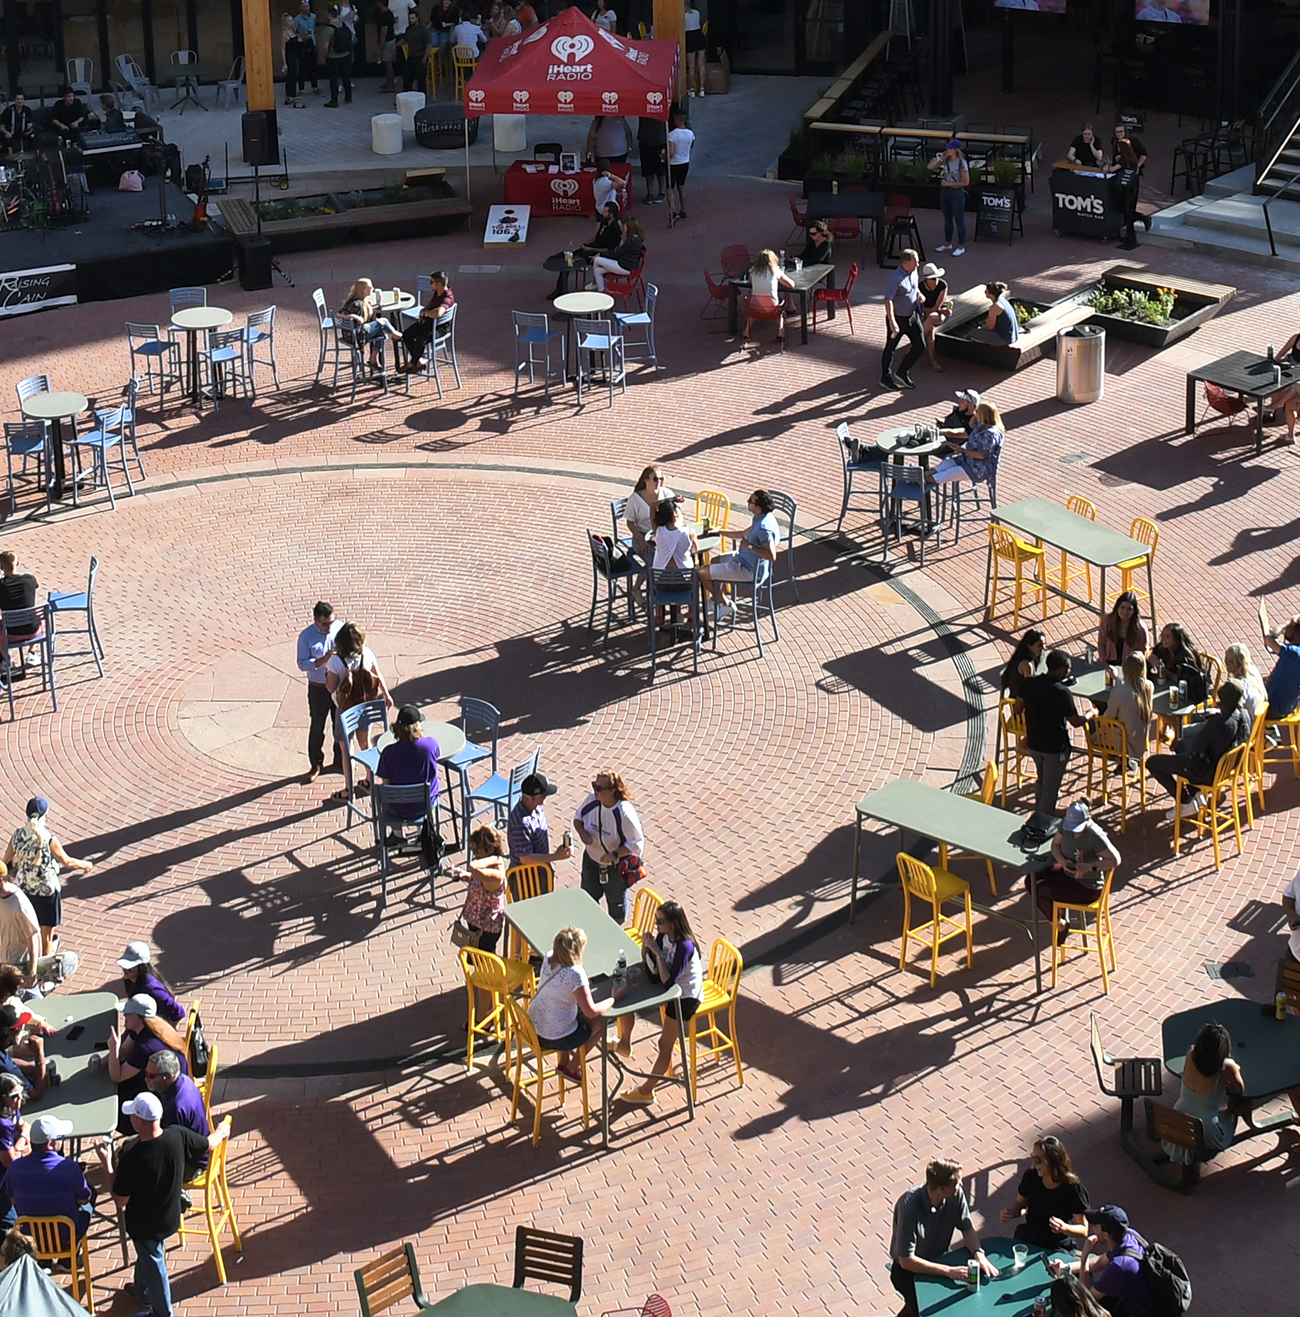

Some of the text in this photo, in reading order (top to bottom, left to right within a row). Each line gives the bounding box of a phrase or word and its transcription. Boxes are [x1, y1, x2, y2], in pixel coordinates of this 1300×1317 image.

[548, 63, 593, 74] iHeart
[546, 72, 593, 81] RADIO
[551, 197, 581, 205] iHeart
[981, 196, 1011, 208] TOM'S
[1054, 192, 1105, 215] TOM'S
[552, 203, 582, 212] RADIO
[2, 290, 48, 310] CAIN
